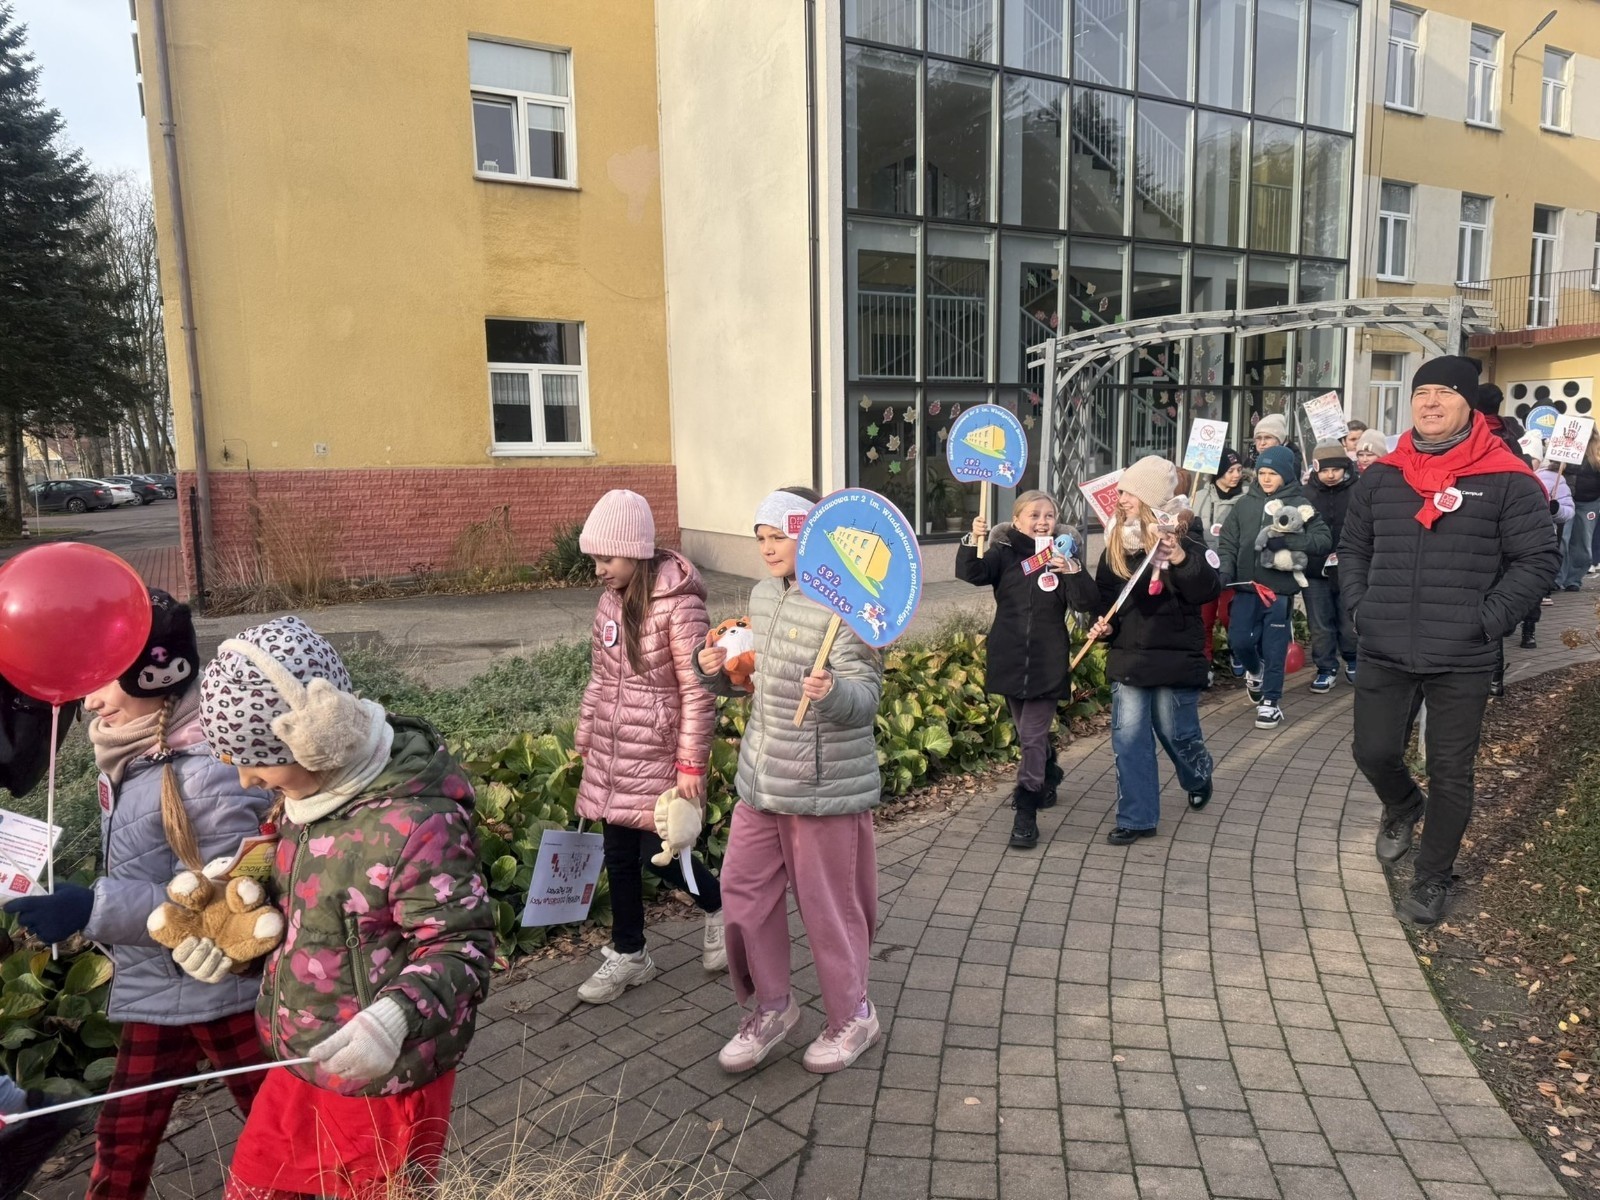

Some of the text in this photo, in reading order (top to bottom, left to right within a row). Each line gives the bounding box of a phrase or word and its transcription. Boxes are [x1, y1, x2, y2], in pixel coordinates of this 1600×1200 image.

[809, 495, 849, 527] Podstawowa
[861, 495, 867, 503] 2
[869, 498, 880, 511] im.
[881, 509, 914, 560] Władysława
[803, 572, 852, 613] w Pasłęku
[896, 562, 918, 626] Broniewskiego
